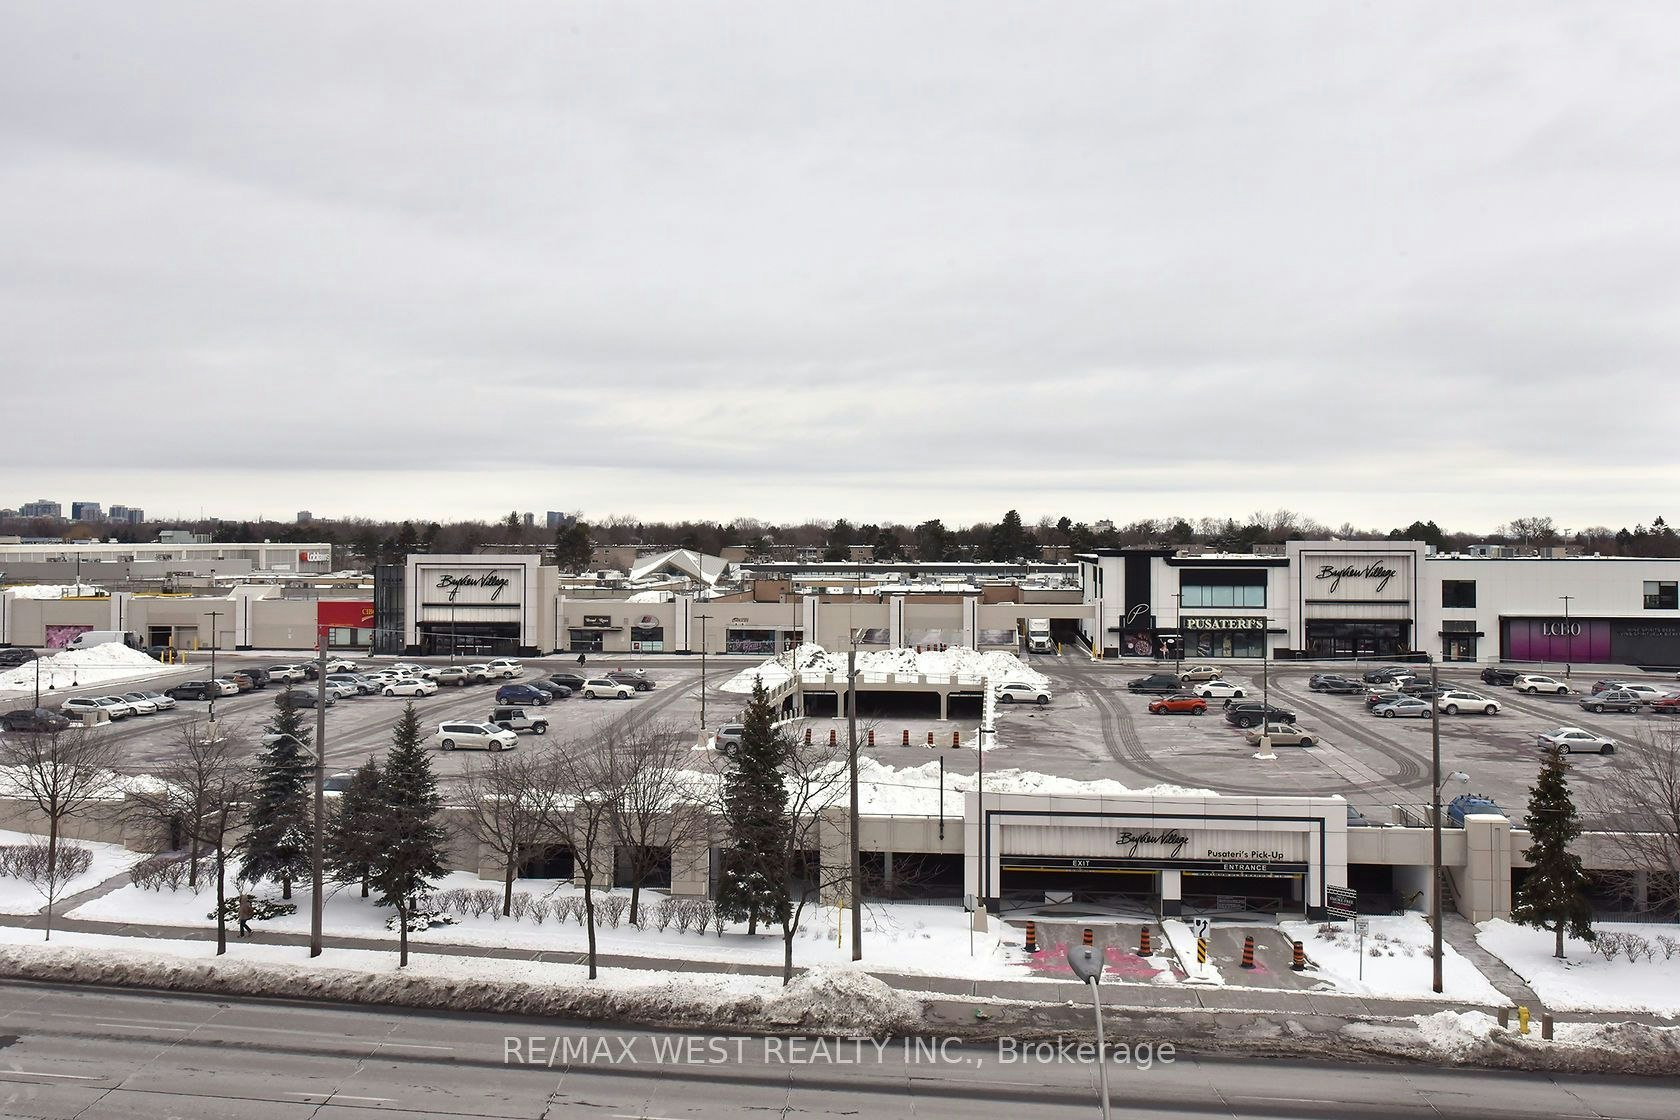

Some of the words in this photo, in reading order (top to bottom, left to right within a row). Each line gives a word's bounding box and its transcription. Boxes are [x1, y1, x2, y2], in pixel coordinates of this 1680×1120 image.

[480, 570, 509, 601] Village
[1365, 560, 1396, 593] Village
[1186, 618, 1264, 630] PUSATERI'S
[1543, 622, 1581, 636] LCBO
[1160, 829, 1189, 858] Village
[1207, 849, 1249, 858] Pusateri's
[1251, 850, 1284, 860] Pick-Up
